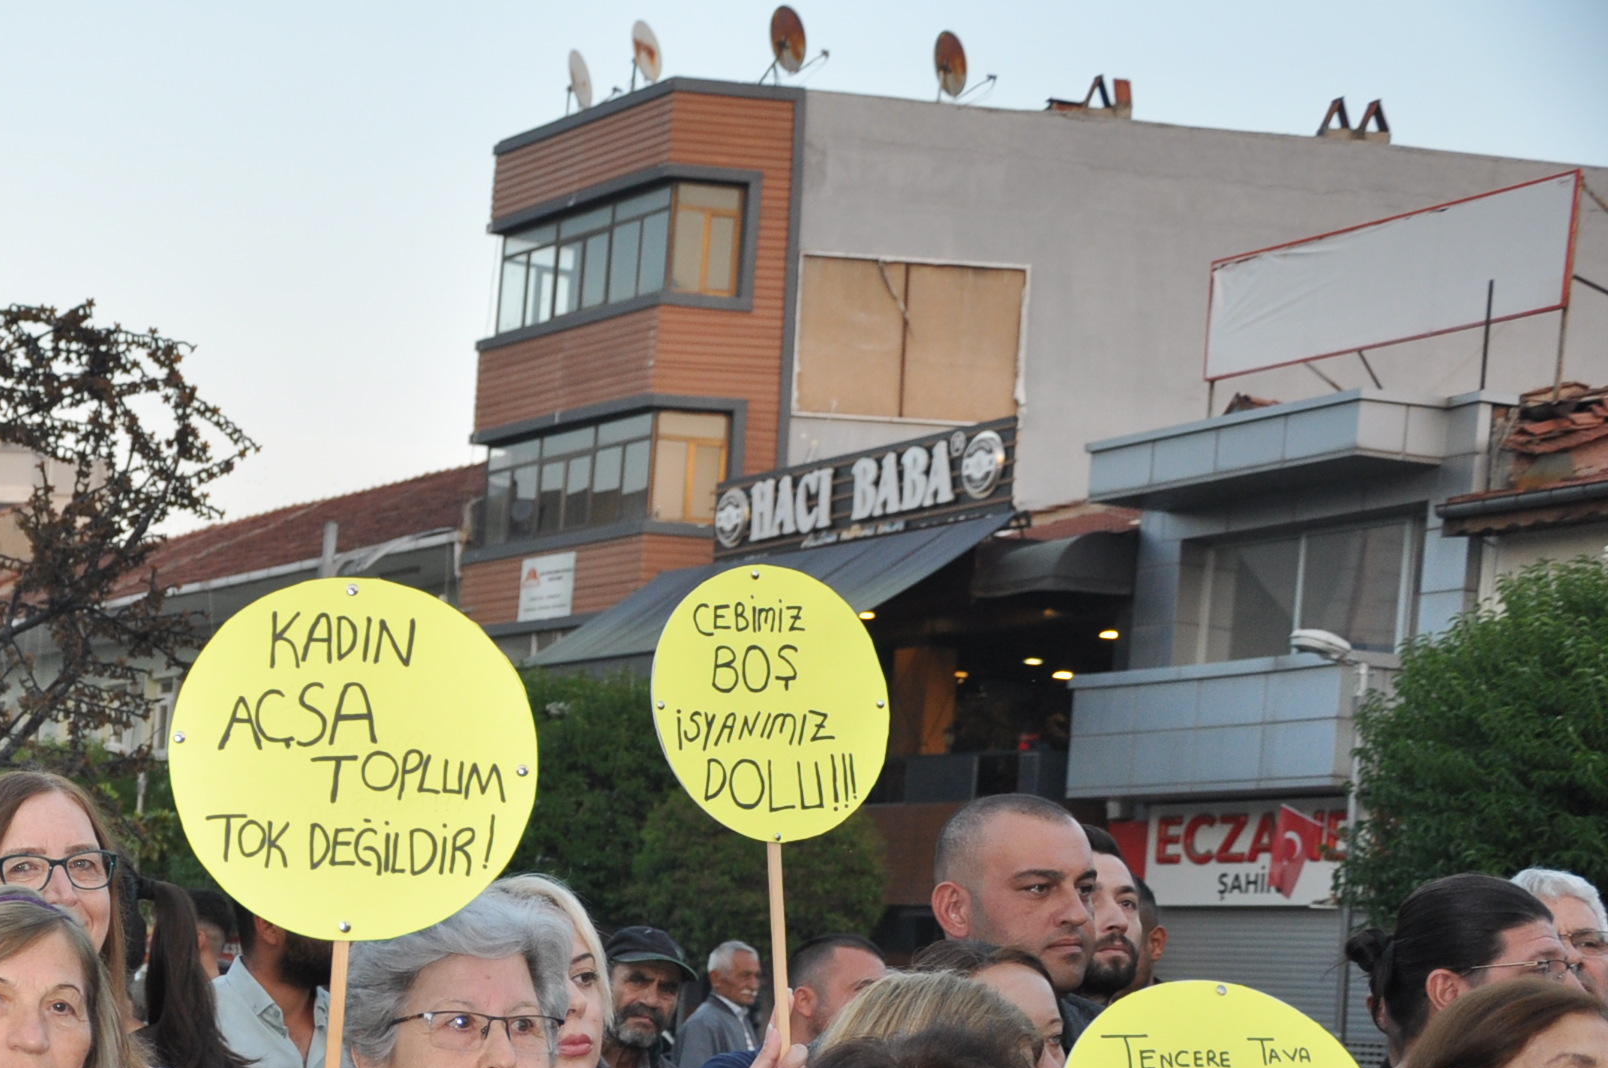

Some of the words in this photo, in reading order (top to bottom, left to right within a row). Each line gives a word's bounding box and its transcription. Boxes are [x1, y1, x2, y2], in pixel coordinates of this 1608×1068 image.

[749, 467, 834, 542] HACI
[851, 440, 954, 521] BABA
[270, 611, 416, 669] KADIN
[693, 595, 805, 637] CEBİMİZ
[712, 644, 798, 693] BOŞ
[676, 709, 835, 751] İSYANIMIZ
[310, 749, 506, 804] TOPLUM
[703, 753, 859, 812] DOLU!!!
[205, 814, 290, 869] TOK
[309, 814, 495, 877] DEĞİLDİR!
[1247, 1038, 1311, 1066] TAVA
